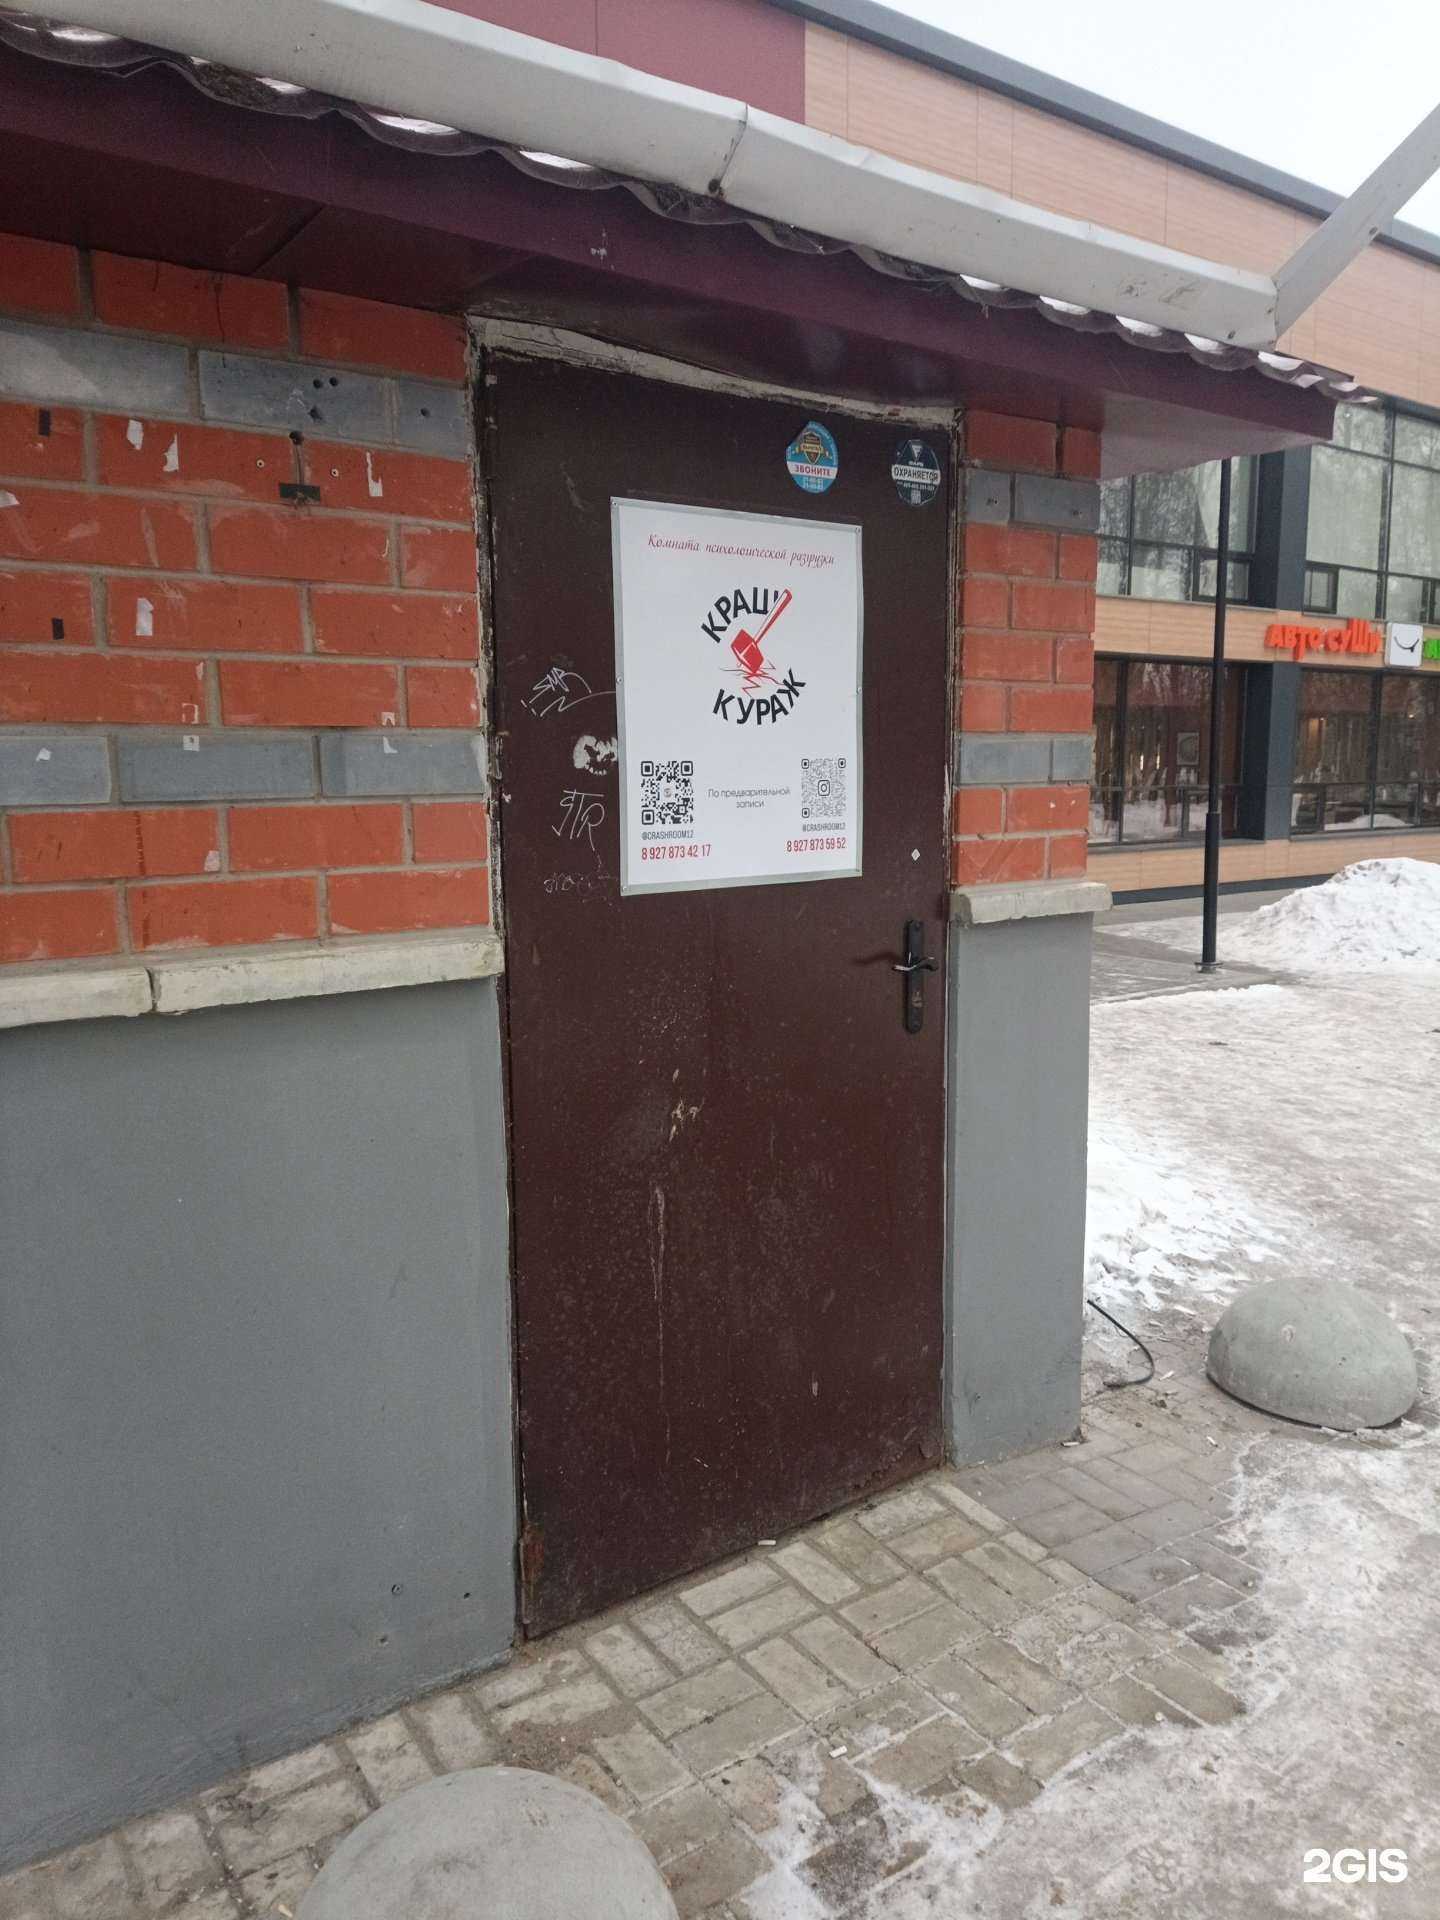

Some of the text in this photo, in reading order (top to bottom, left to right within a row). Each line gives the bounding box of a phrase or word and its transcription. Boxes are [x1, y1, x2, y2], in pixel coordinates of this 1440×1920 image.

[794, 464, 832, 477] ЗВОНИТЕ
[894, 466, 939, 482] ОХРАНЯЕТСЯ
[648, 534, 835, 568] Комната психологической разгрузки
[712, 668, 807, 725] КУРАЖ
[708, 786, 790, 798] По предварительной
[736, 800, 765, 809] записи
[641, 829, 694, 840] @CRASHROOM12
[641, 843, 711, 860] 8 927 873 42 17
[786, 840, 792, 852] 8
[793, 839, 808, 852] 927
[809, 838, 824, 850] 873
[836, 837, 846, 849] 52
